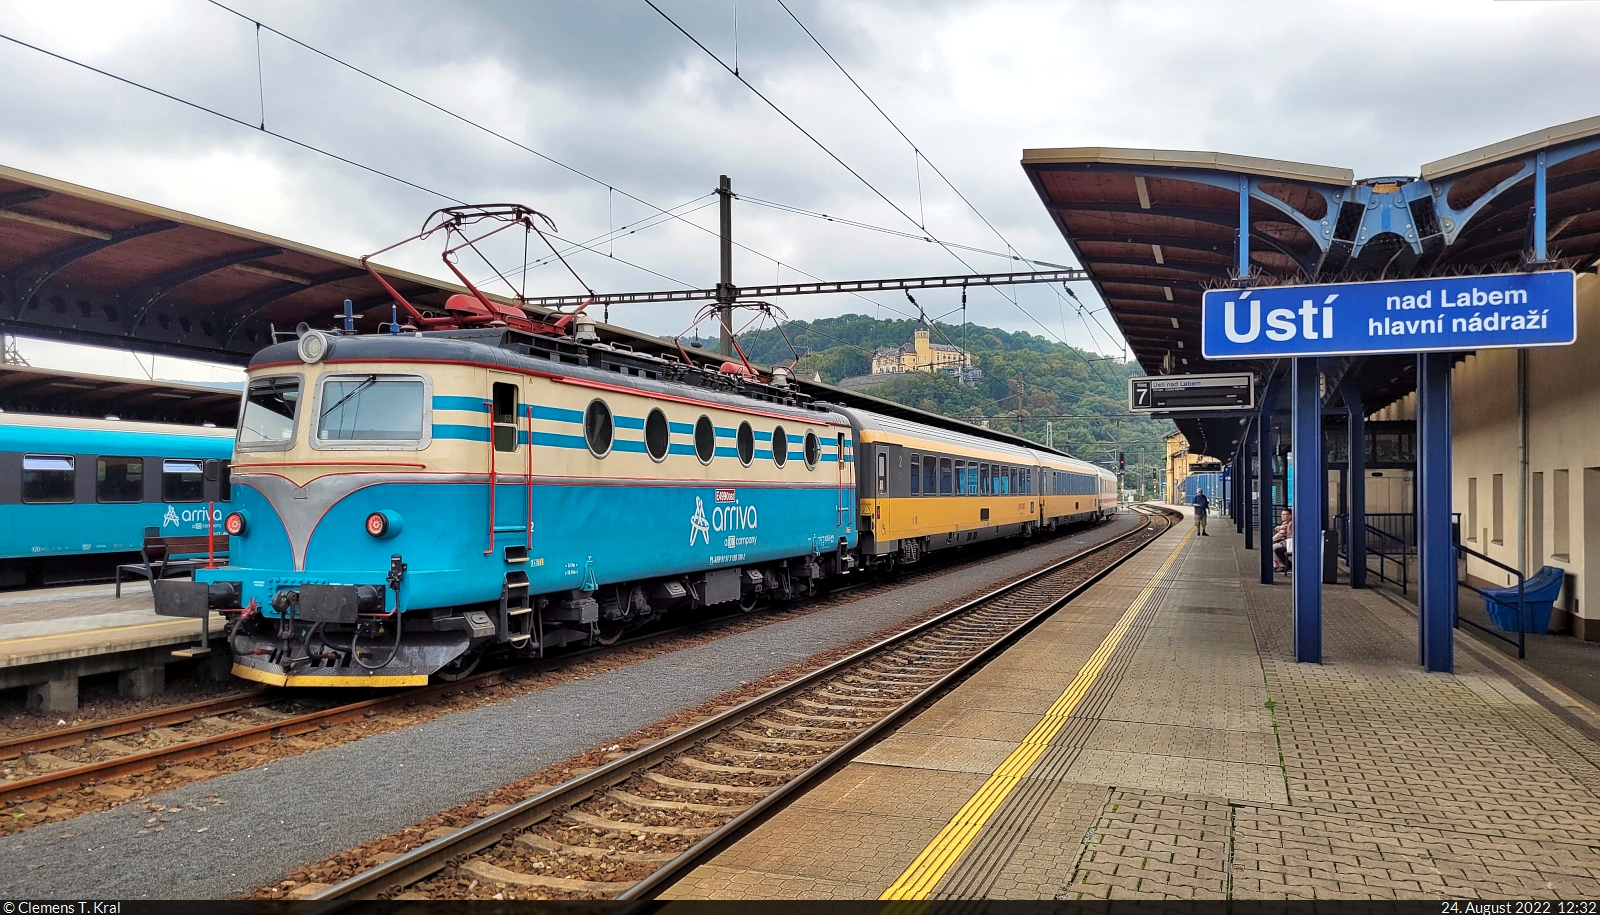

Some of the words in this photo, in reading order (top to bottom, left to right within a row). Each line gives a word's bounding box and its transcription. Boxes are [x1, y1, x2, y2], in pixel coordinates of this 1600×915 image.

[1387, 289, 1432, 311] nad
[1441, 287, 1528, 309] Labem
[1224, 291, 1339, 344] Ústí
[1368, 313, 1444, 337] hlavní
[1452, 309, 1550, 333] nádraží
[1137, 388, 1147, 404] 7
[712, 498, 758, 532] arriva
[736, 535, 757, 547] company
